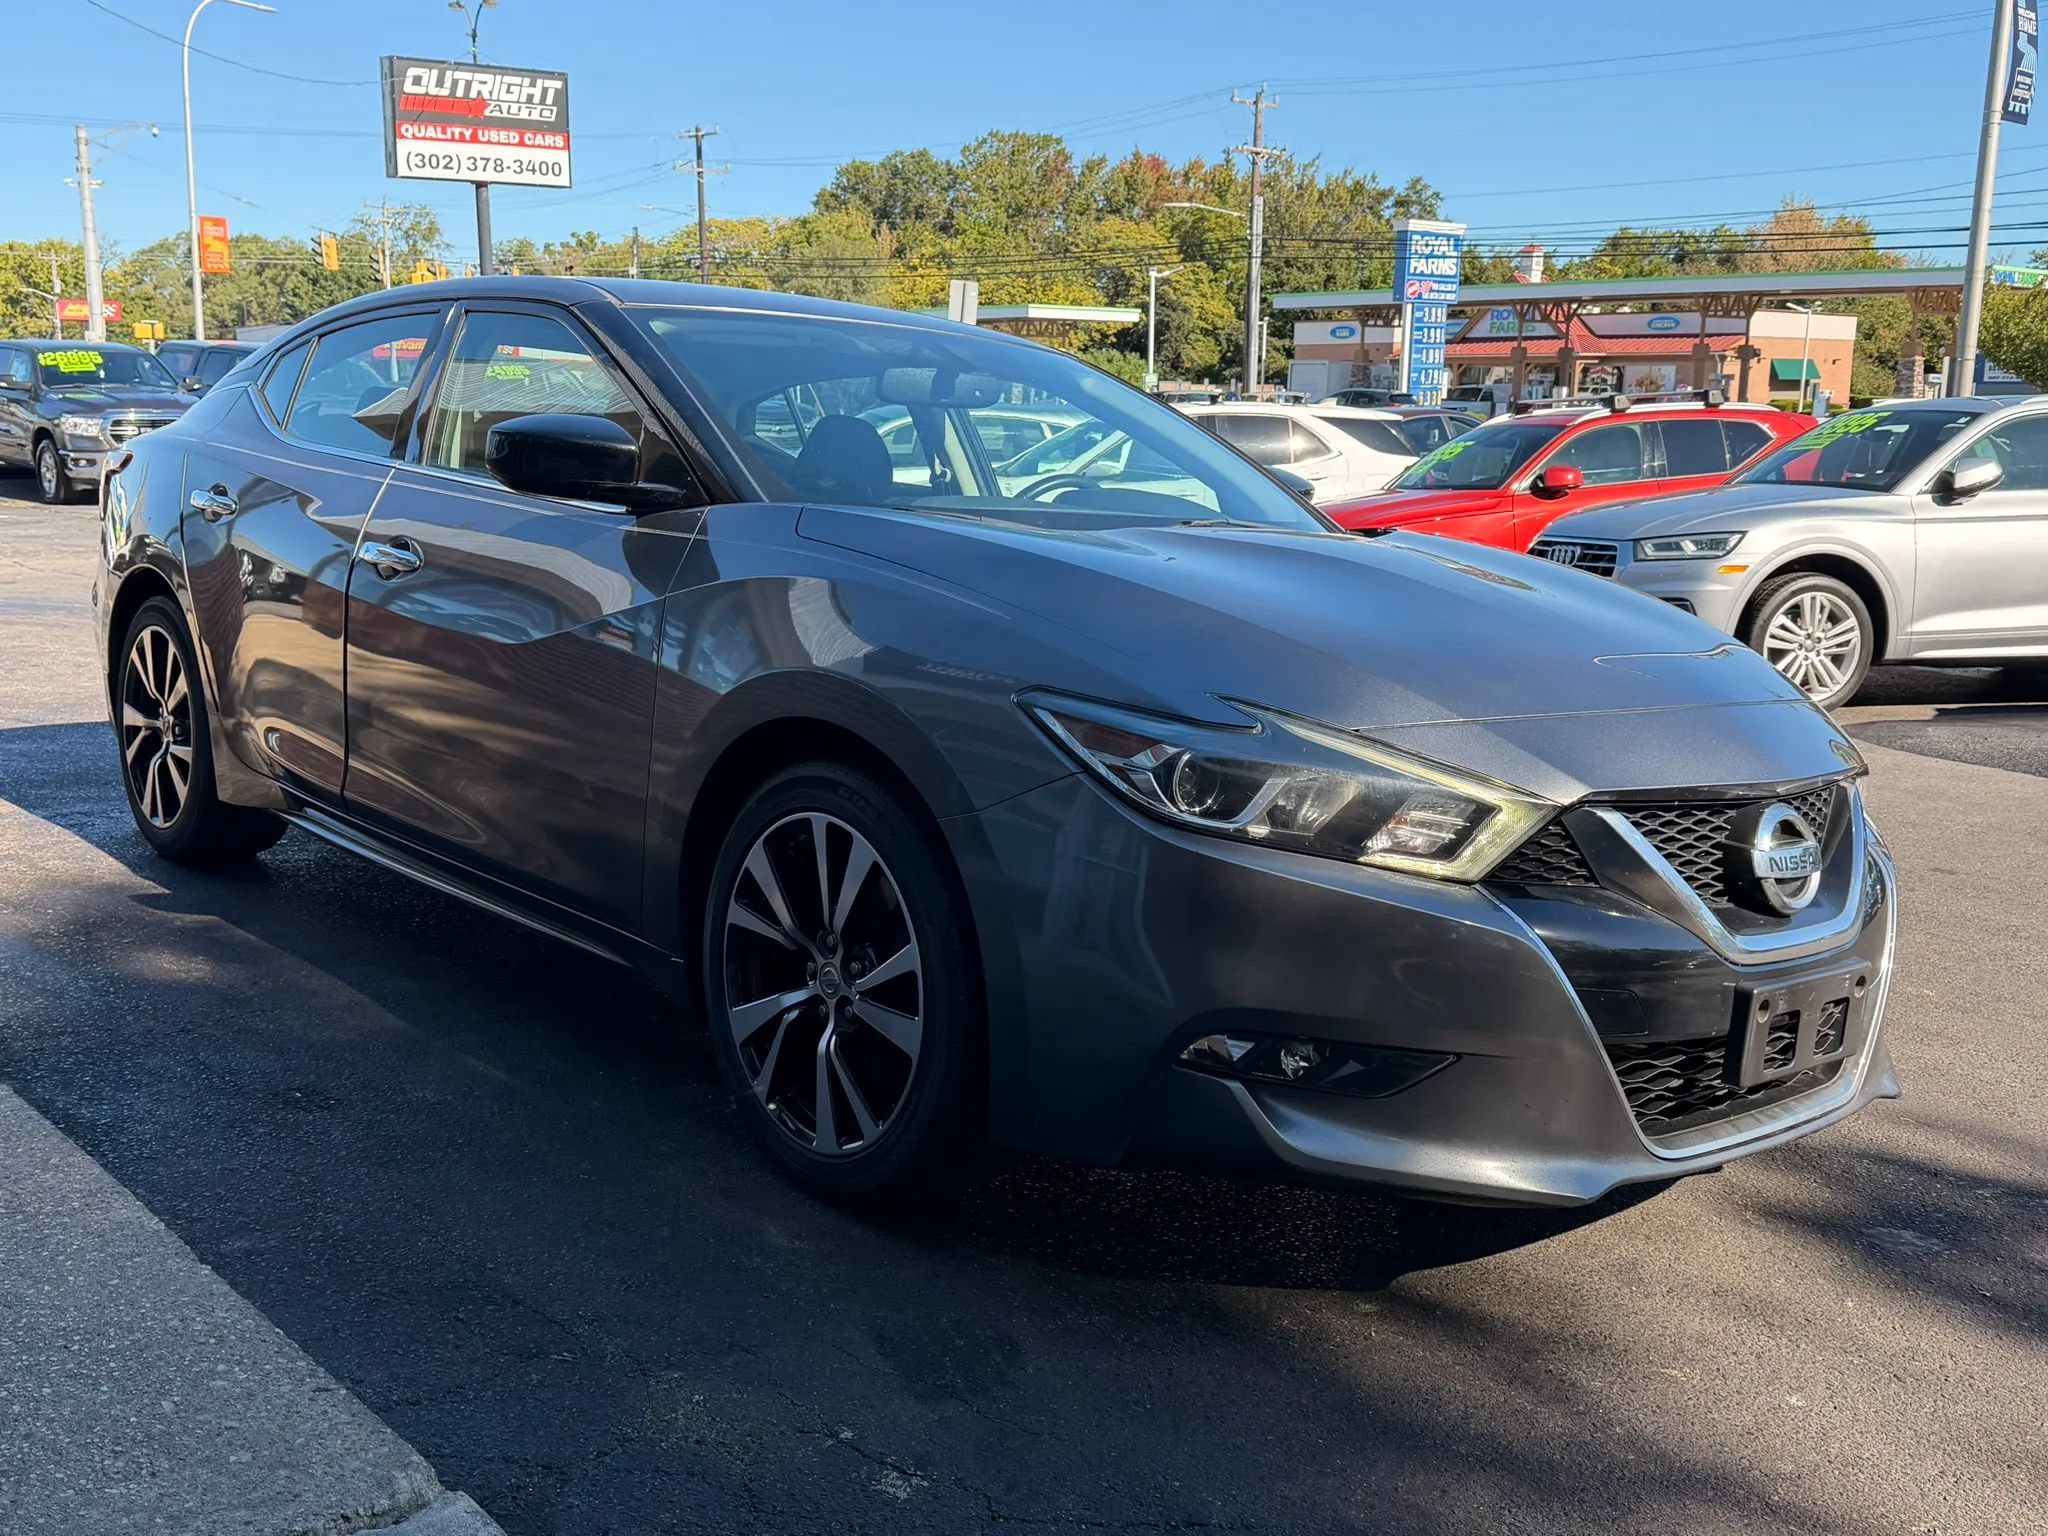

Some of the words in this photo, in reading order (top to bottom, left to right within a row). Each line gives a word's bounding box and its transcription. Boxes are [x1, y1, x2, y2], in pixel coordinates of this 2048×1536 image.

[403, 66, 563, 105] OUTRIGHT
[489, 103, 554, 119] AUTO
[401, 123, 474, 141] QUALITY
[477, 128, 520, 144] USED
[523, 132, 565, 148] CARS
[406, 151, 462, 174] (302)
[466, 156, 562, 177] 378-3400
[1411, 234, 1457, 256] ROYAL
[1409, 254, 1457, 276] FARMS
[1769, 850, 1821, 873] NISSAN
